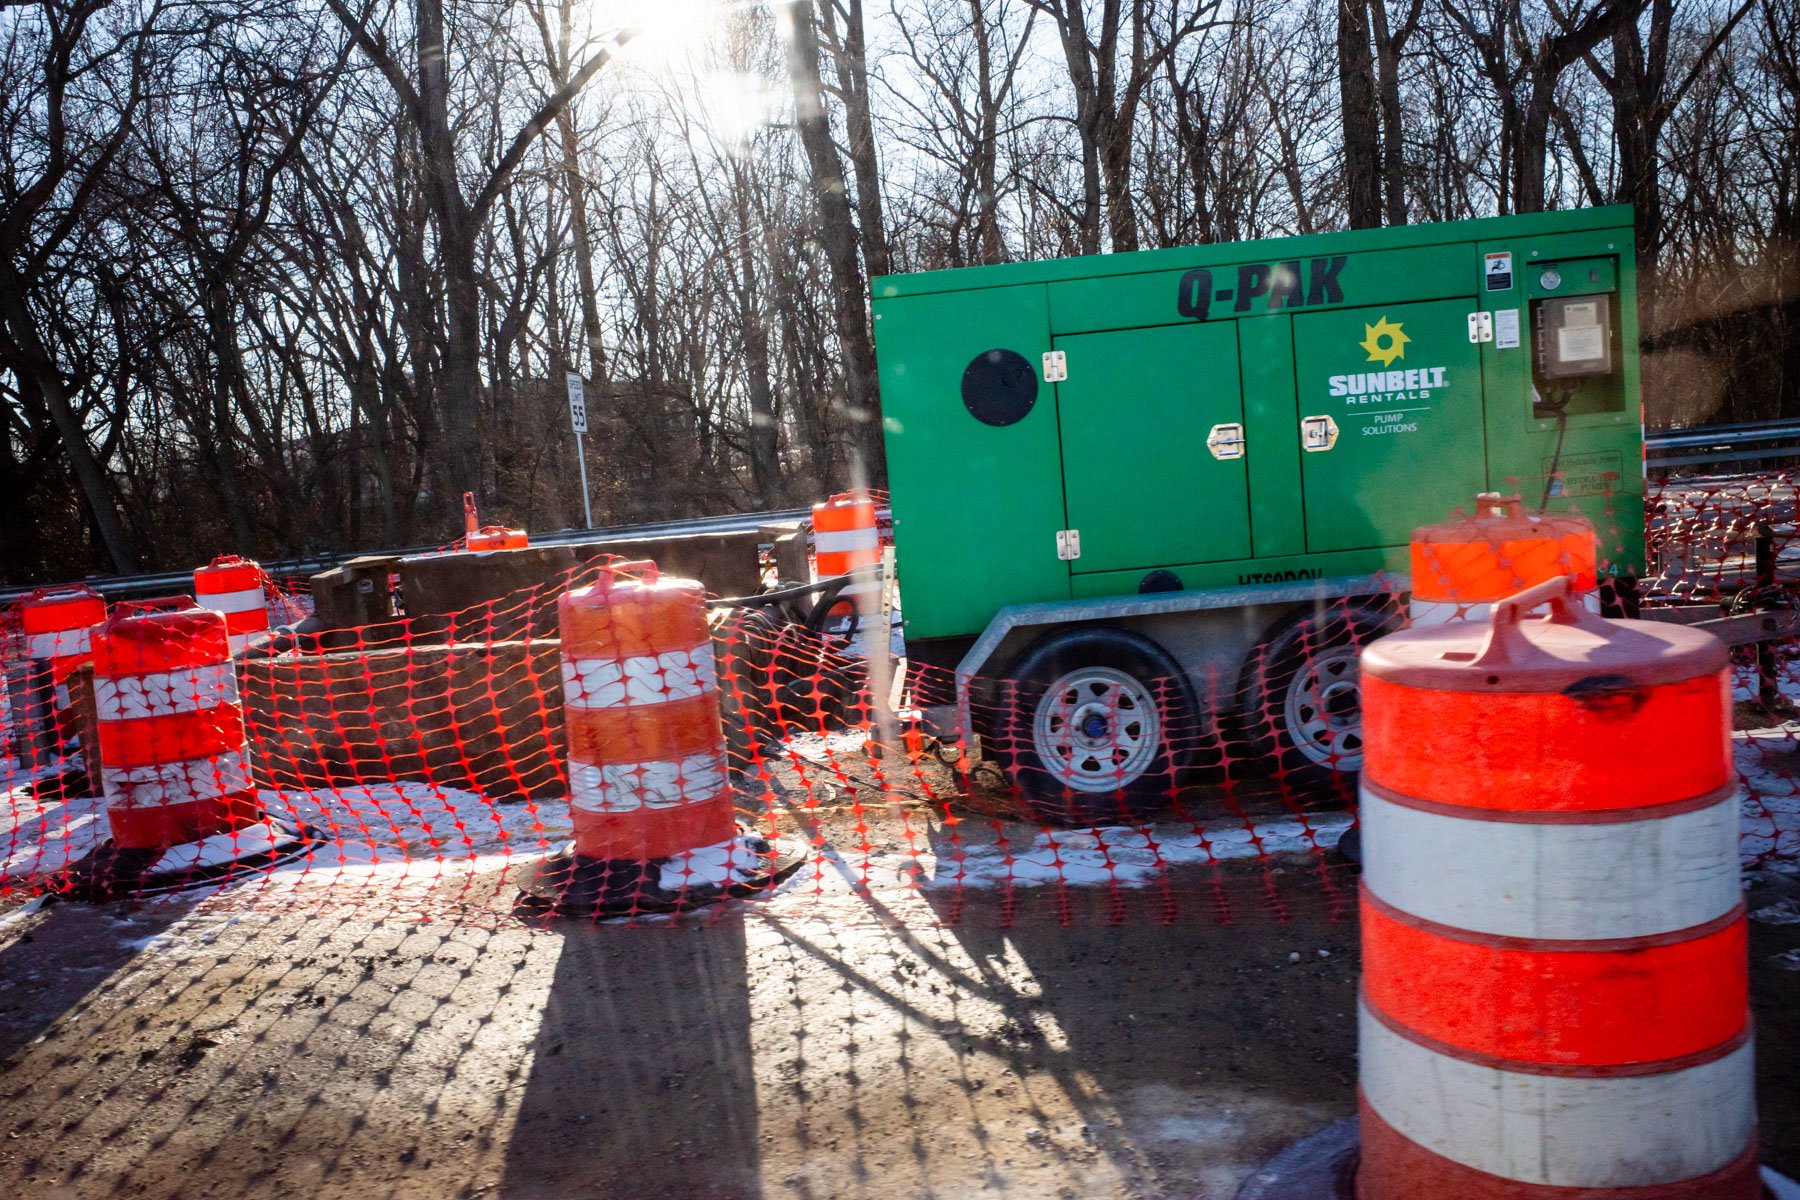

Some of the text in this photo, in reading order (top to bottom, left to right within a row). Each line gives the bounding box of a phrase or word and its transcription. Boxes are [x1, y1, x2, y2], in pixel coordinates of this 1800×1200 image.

[1177, 256, 1348, 321] Q-PAK
[1328, 366, 1447, 397] SUNBELT
[1346, 389, 1431, 405] RENTALS
[572, 404, 585, 427] 55
[1374, 413, 1404, 424] PUMP
[1362, 422, 1418, 436] SOLUTIONS
